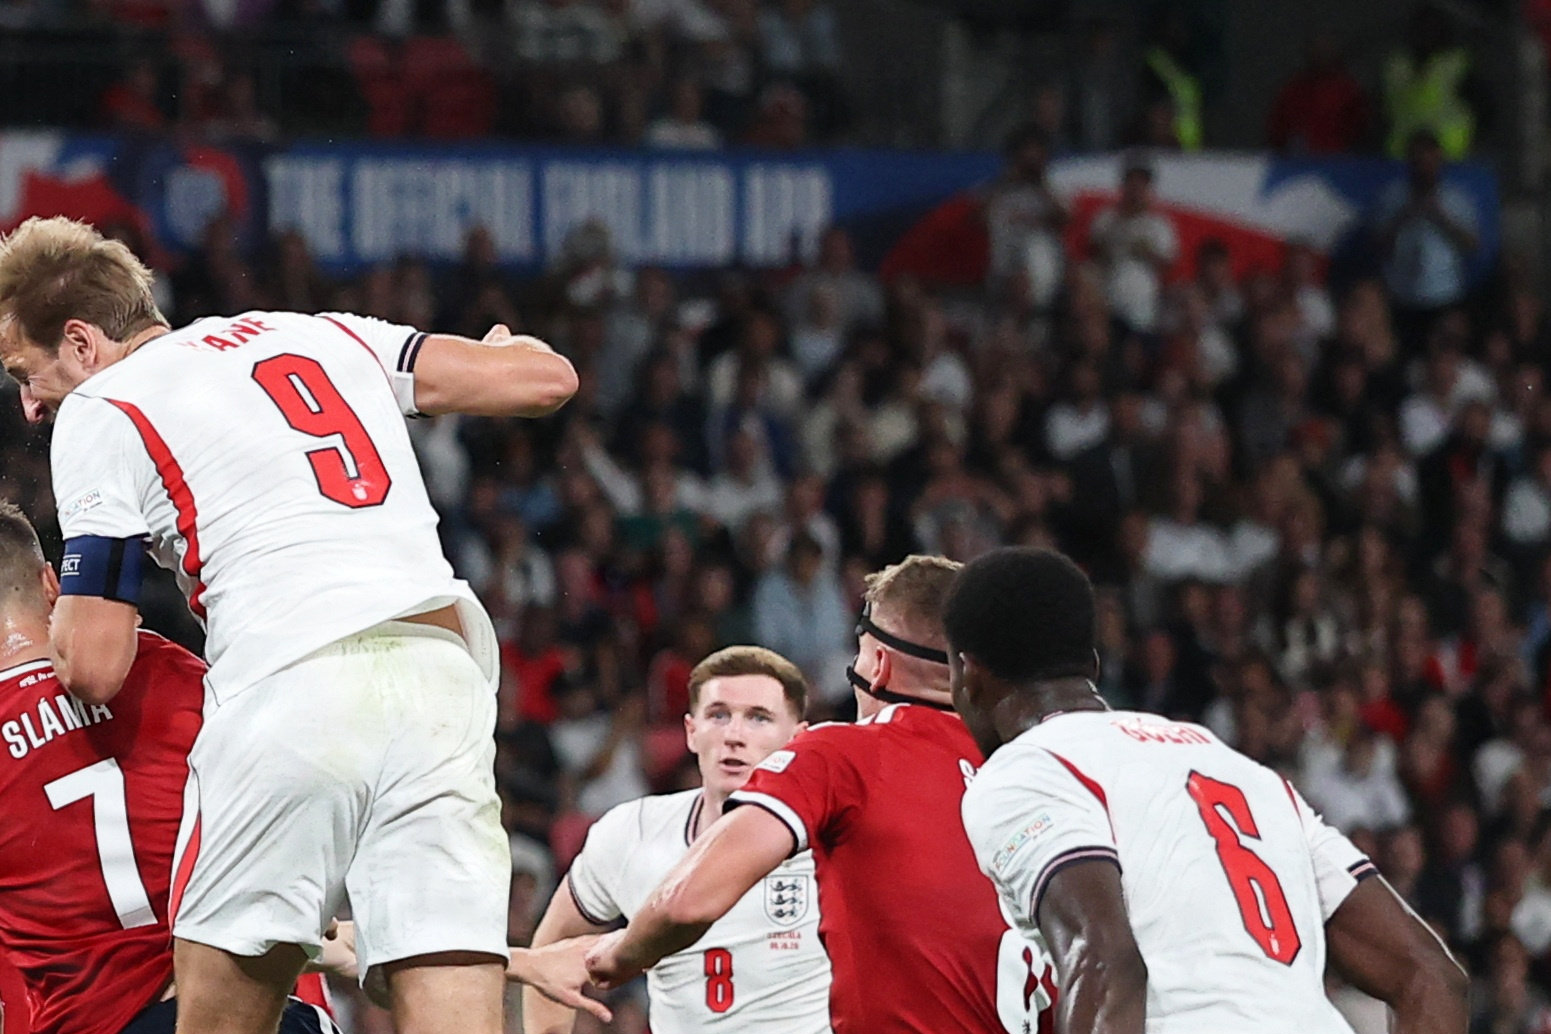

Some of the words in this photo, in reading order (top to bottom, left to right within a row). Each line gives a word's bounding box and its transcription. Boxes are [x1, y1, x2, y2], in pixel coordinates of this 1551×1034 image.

[175, 317, 277, 352] ANE
[251, 352, 392, 509] 9
[1, 693, 114, 759] SLÁMA
[43, 756, 159, 931] 7
[1185, 768, 1302, 967] 6
[704, 946, 735, 1013] 8
